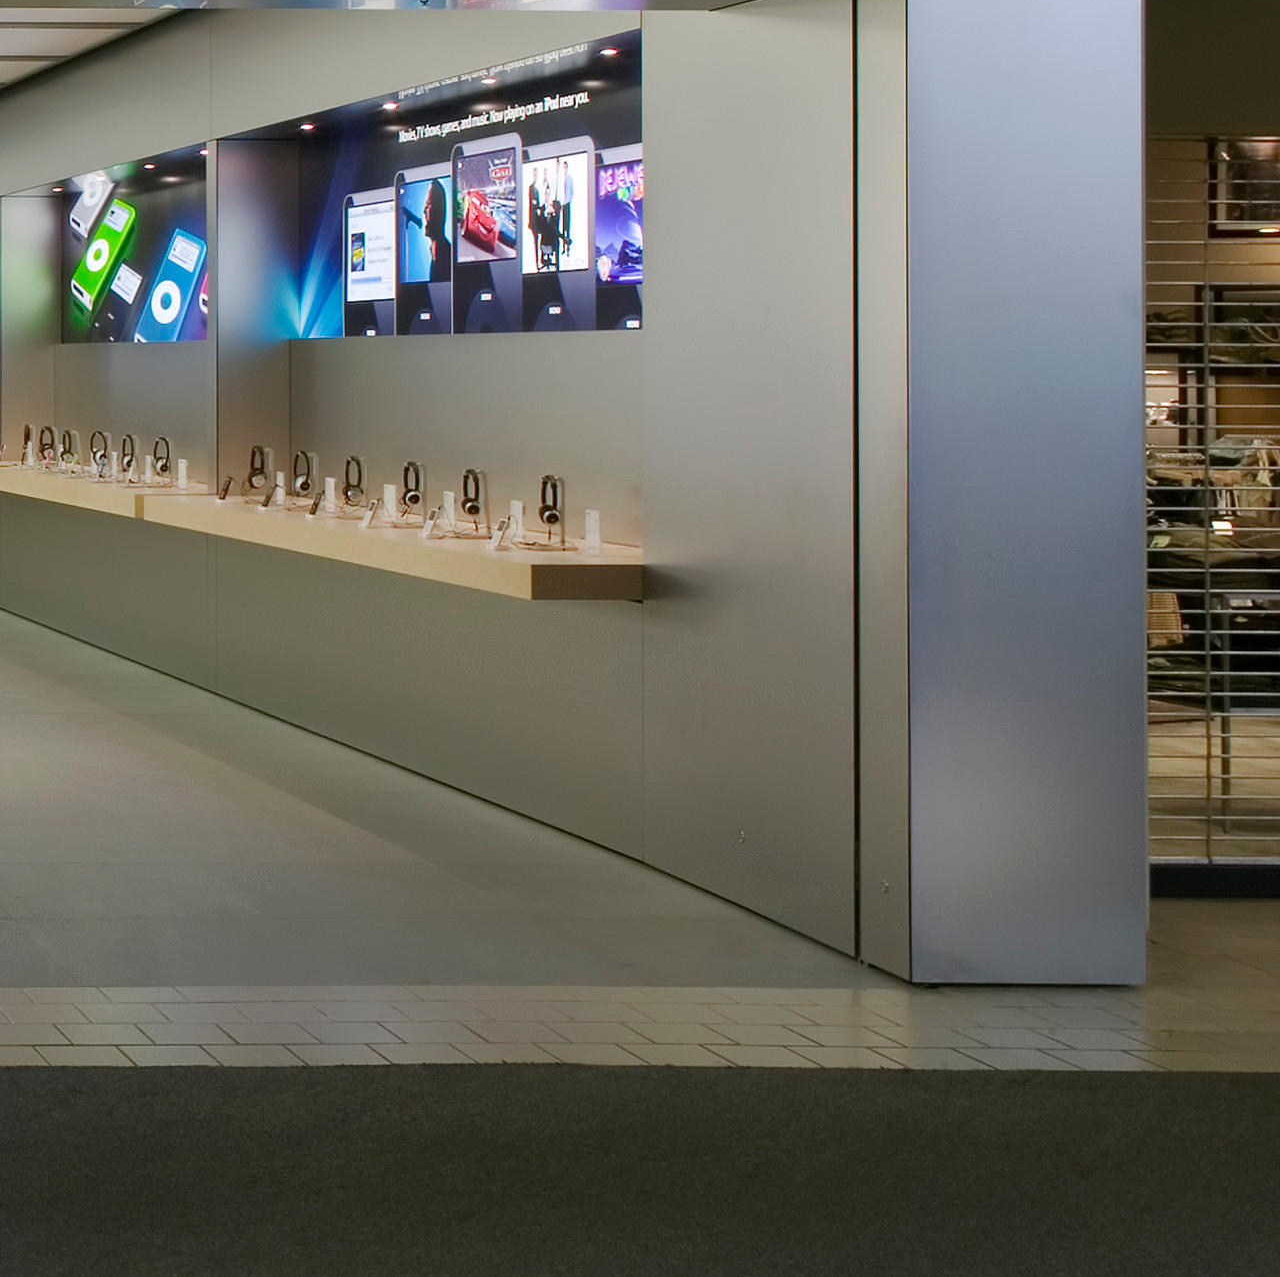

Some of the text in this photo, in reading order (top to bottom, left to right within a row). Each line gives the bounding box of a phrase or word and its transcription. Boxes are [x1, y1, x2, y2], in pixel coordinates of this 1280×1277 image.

[460, 114, 472, 130] and
[489, 109, 503, 123] Now
[503, 104, 526, 124] playing
[526, 103, 535, 116] on
[535, 101, 544, 114] an
[544, 94, 559, 111] iPod
[559, 94, 574, 108] near
